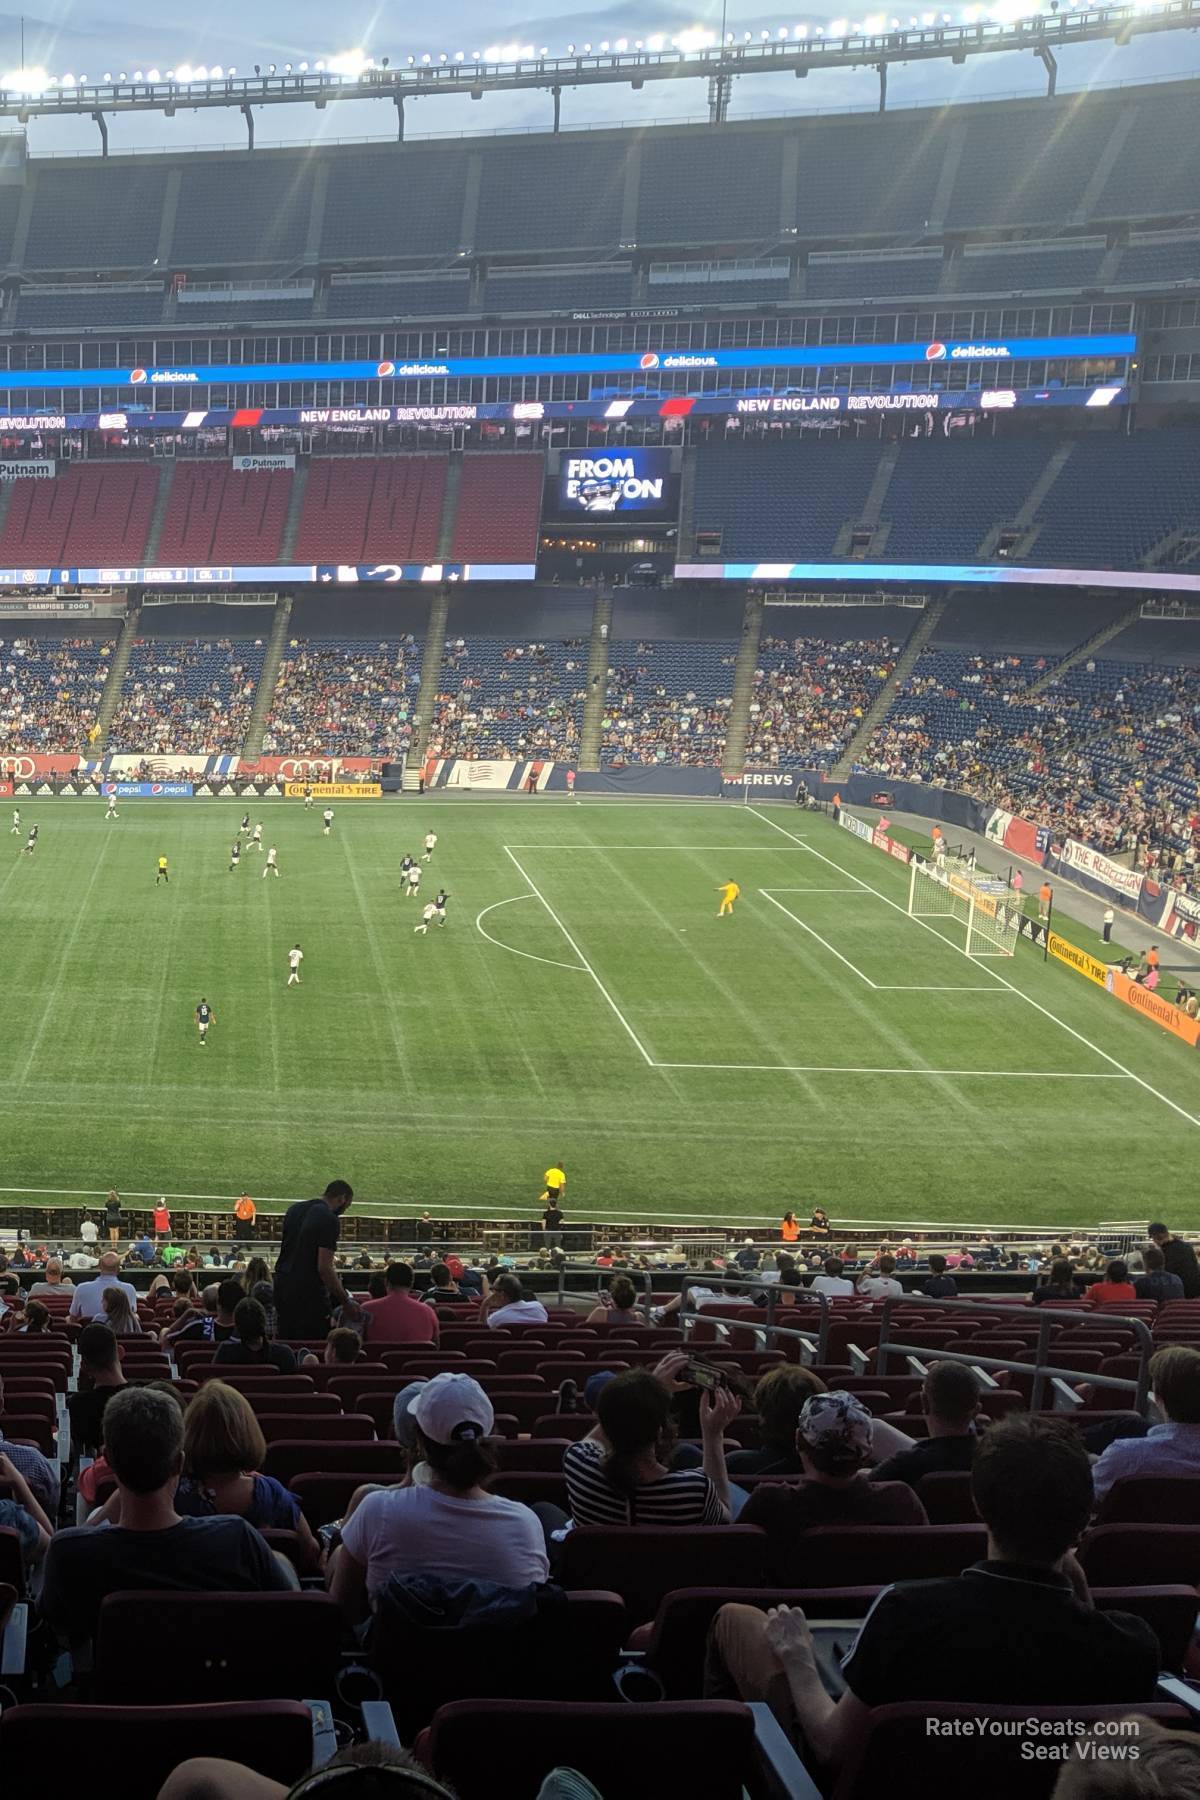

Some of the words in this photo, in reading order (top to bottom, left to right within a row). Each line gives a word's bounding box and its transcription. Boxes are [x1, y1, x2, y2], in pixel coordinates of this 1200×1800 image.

[952, 346, 1010, 357] delicious.
[664, 356, 718, 366] delicious.
[400, 364, 449, 375] delicious.
[151, 372, 198, 382] delicious.
[738, 400, 770, 412] NEW
[773, 398, 840, 410] ENGLAND
[848, 395, 938, 409] REVOLUTION
[301, 411, 329, 422] NEW
[332, 410, 390, 421] ENGLAND
[398, 406, 476, 420] REVOLUTION
[252, 458, 286, 467] Putnam
[568, 458, 634, 478] FROM
[0, 464, 50, 475] Putnam
[61, 570, 69, 582] 0
[118, 786, 141, 794] pepsi
[164, 786, 188, 794] pepsi
[289, 784, 344, 795] Connental
[1075, 846, 1089, 865] THE
[1093, 856, 1140, 892] REBELLION
[1050, 936, 1084, 968] Continental
[1090, 964, 1106, 982] TIRE
[1128, 986, 1173, 1025] Continental
